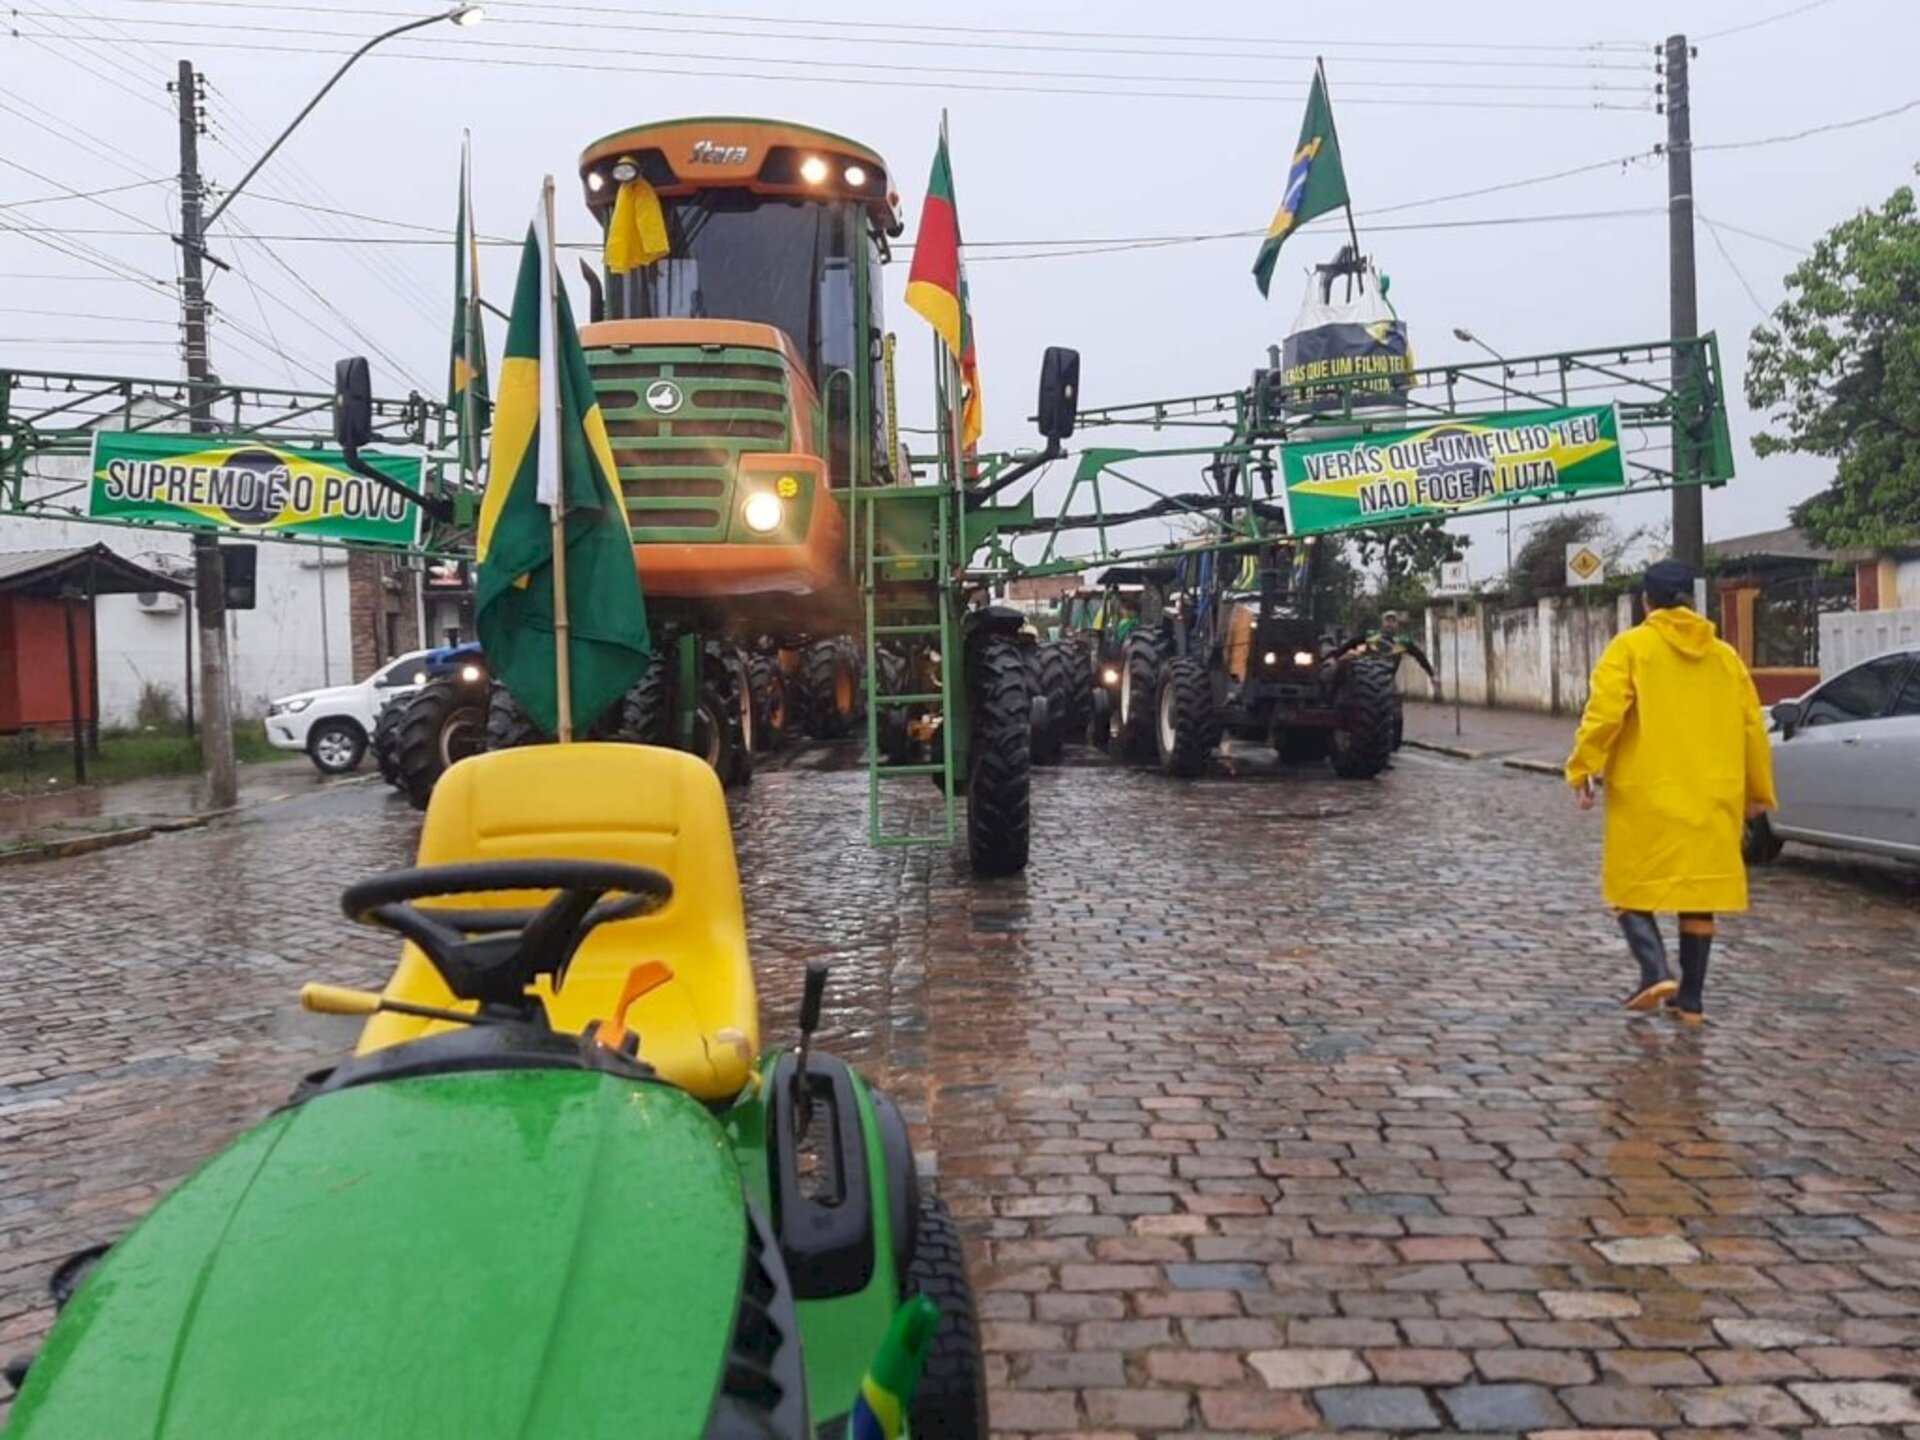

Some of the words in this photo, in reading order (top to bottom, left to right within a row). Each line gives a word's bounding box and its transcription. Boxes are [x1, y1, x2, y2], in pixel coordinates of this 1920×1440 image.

[1306, 359, 1330, 379] QUE
[1331, 356, 1353, 377] UM
[1354, 354, 1388, 374] FILHO
[1305, 443, 1386, 481] VERÁS
[1389, 440, 1437, 470] QUE
[1440, 432, 1481, 462] UM
[1482, 425, 1550, 459] FILHO
[1554, 414, 1600, 448] TEU
[107, 460, 256, 509] SUPREMO
[266, 466, 289, 512] É
[292, 475, 312, 513] O
[321, 476, 407, 521] POVO
[1360, 476, 1410, 514] NÃO
[1414, 471, 1477, 504] FOGE
[1478, 467, 1496, 500] A
[1502, 460, 1558, 493] LUTA
